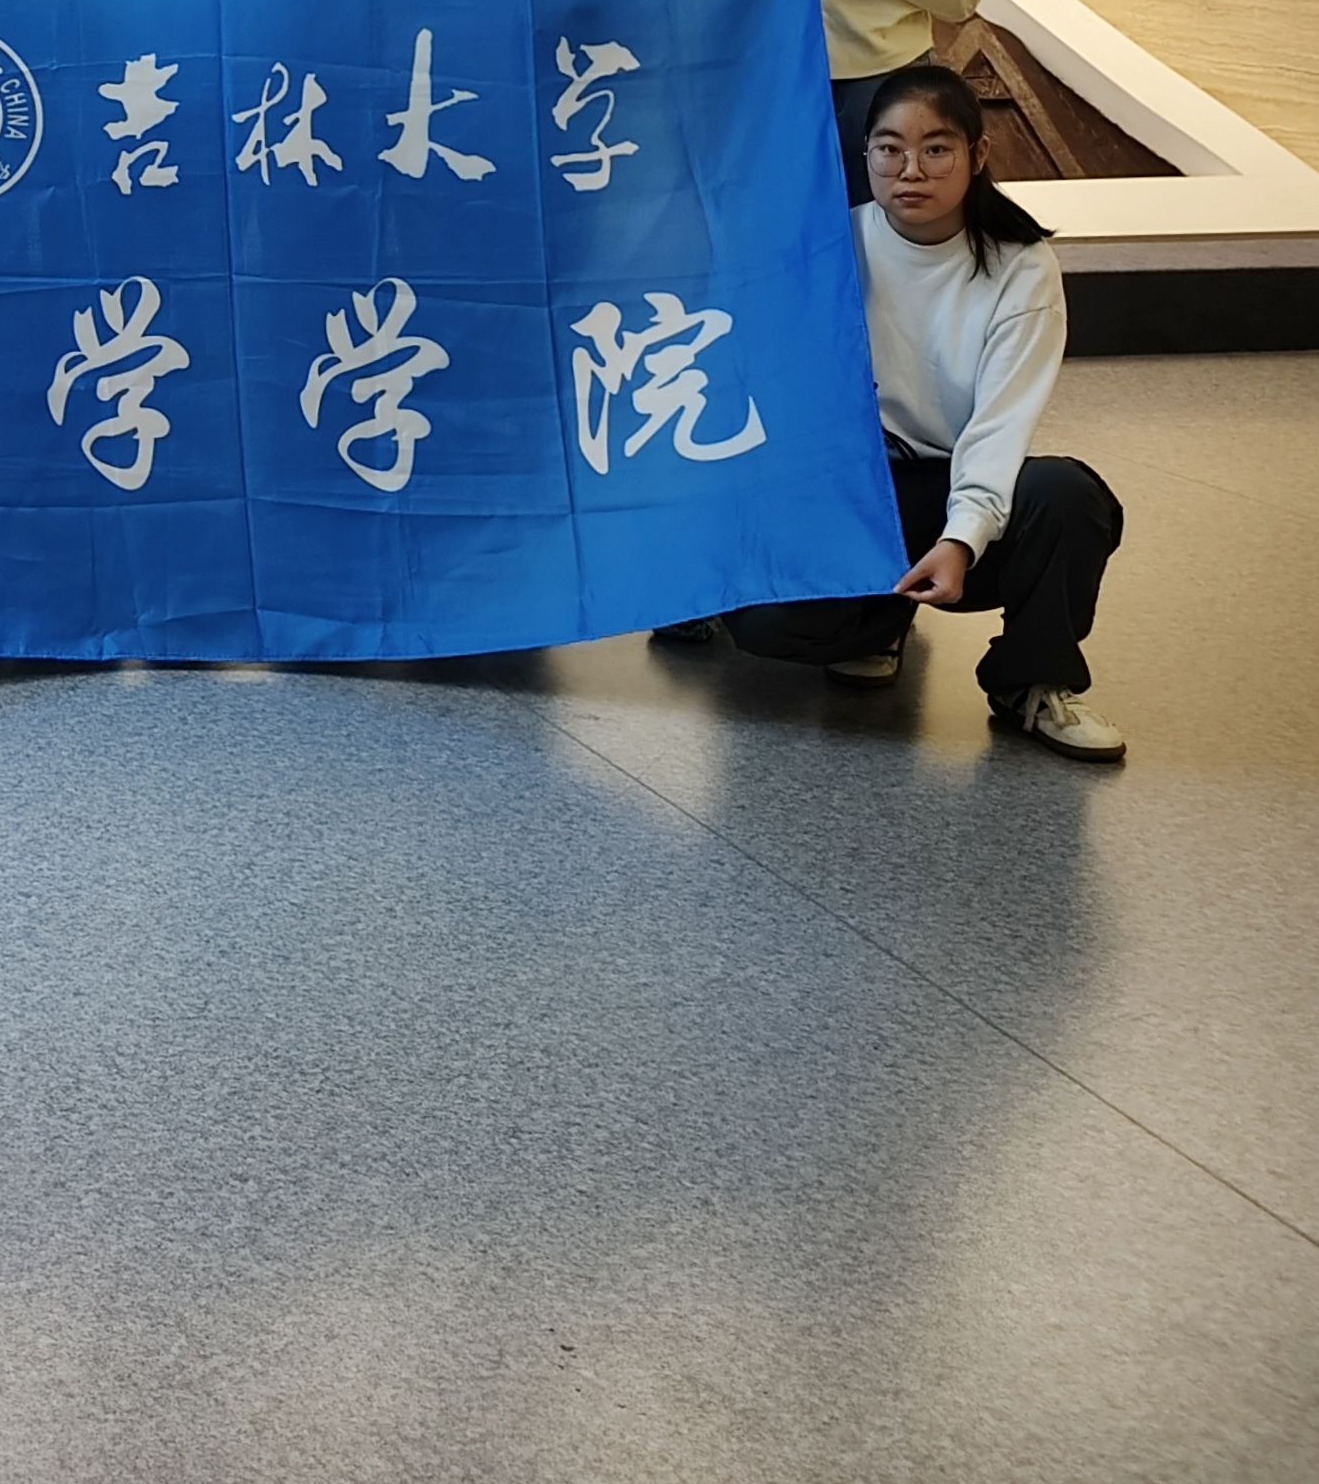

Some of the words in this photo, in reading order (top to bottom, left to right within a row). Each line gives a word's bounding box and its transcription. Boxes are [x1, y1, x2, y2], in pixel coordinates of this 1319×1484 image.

[0, 78, 30, 140] CHINA
[98, 28, 641, 194] 吉林大学
